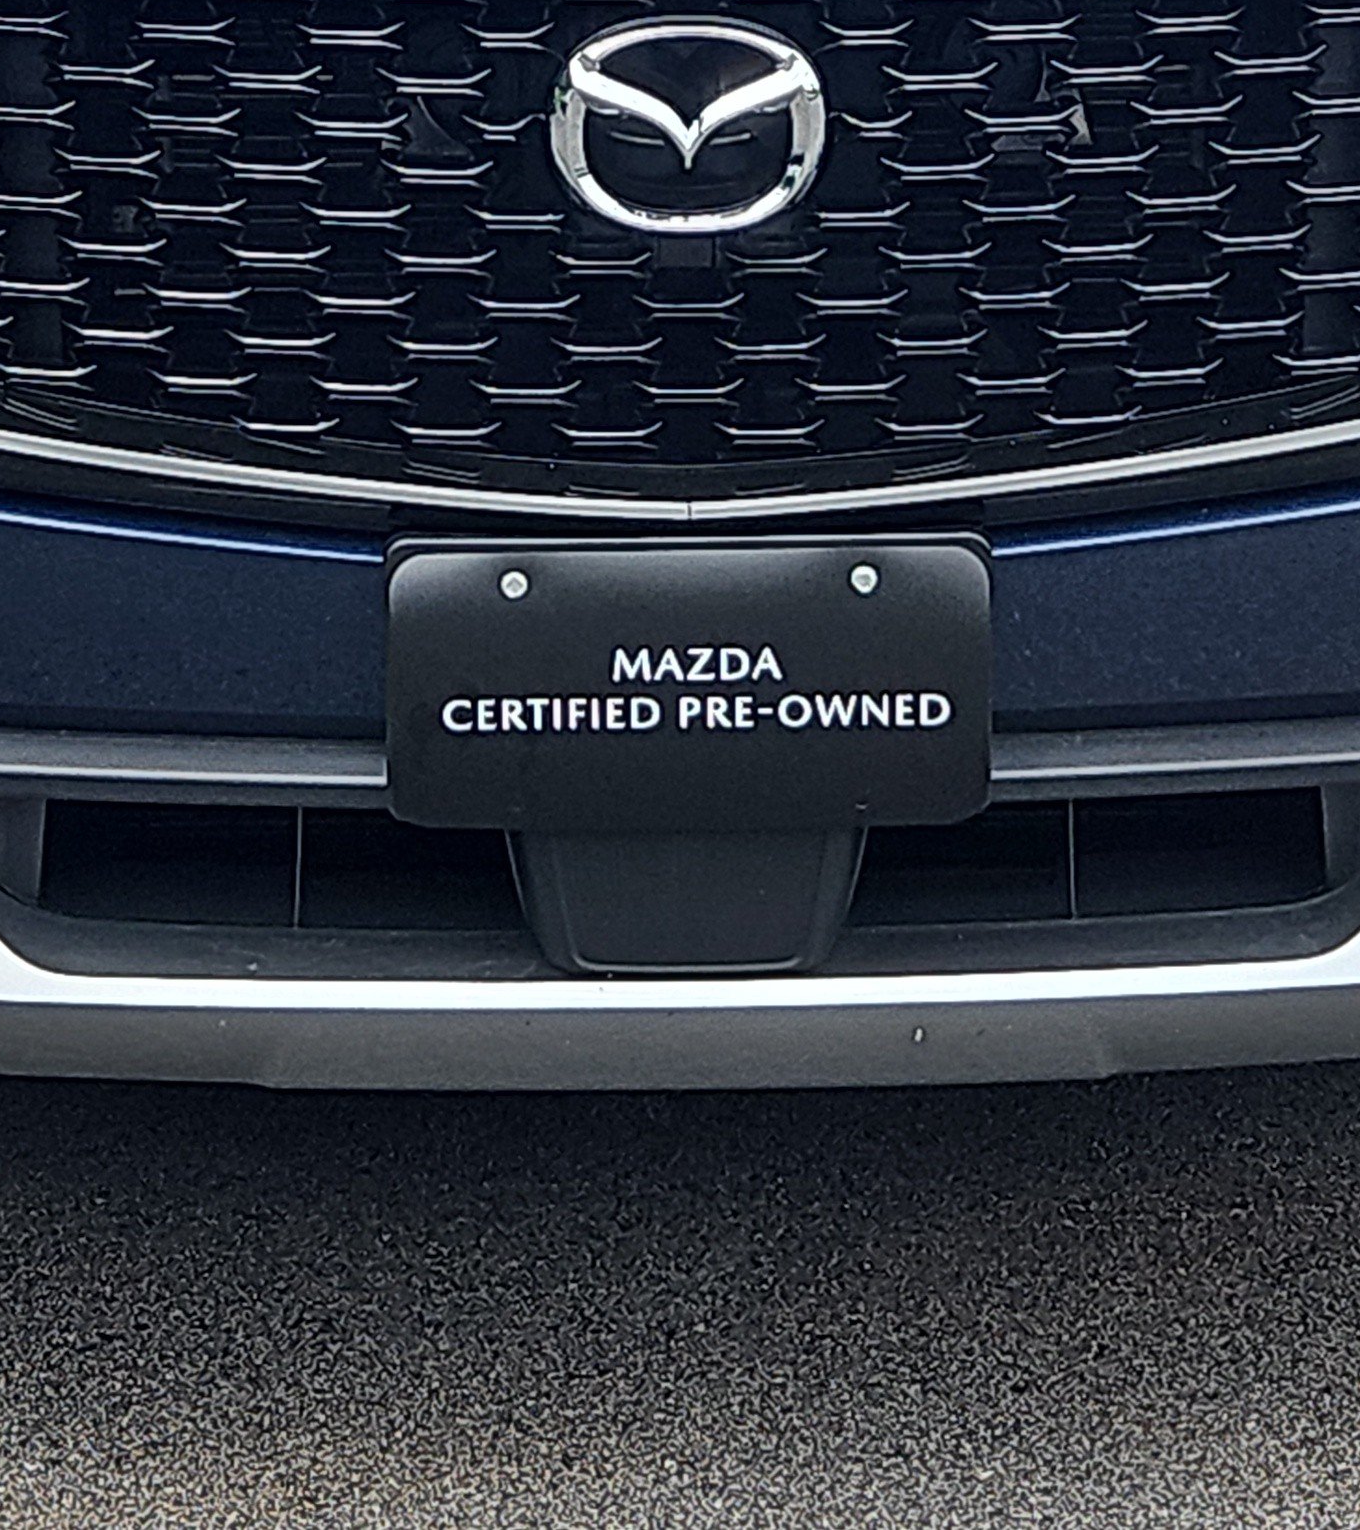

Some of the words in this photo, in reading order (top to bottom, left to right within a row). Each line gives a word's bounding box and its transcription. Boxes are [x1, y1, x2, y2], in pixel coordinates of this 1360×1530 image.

[610, 646, 784, 684] MAZDA
[441, 695, 662, 732] CERTIFIED
[677, 692, 953, 729] PRE-OWNED
